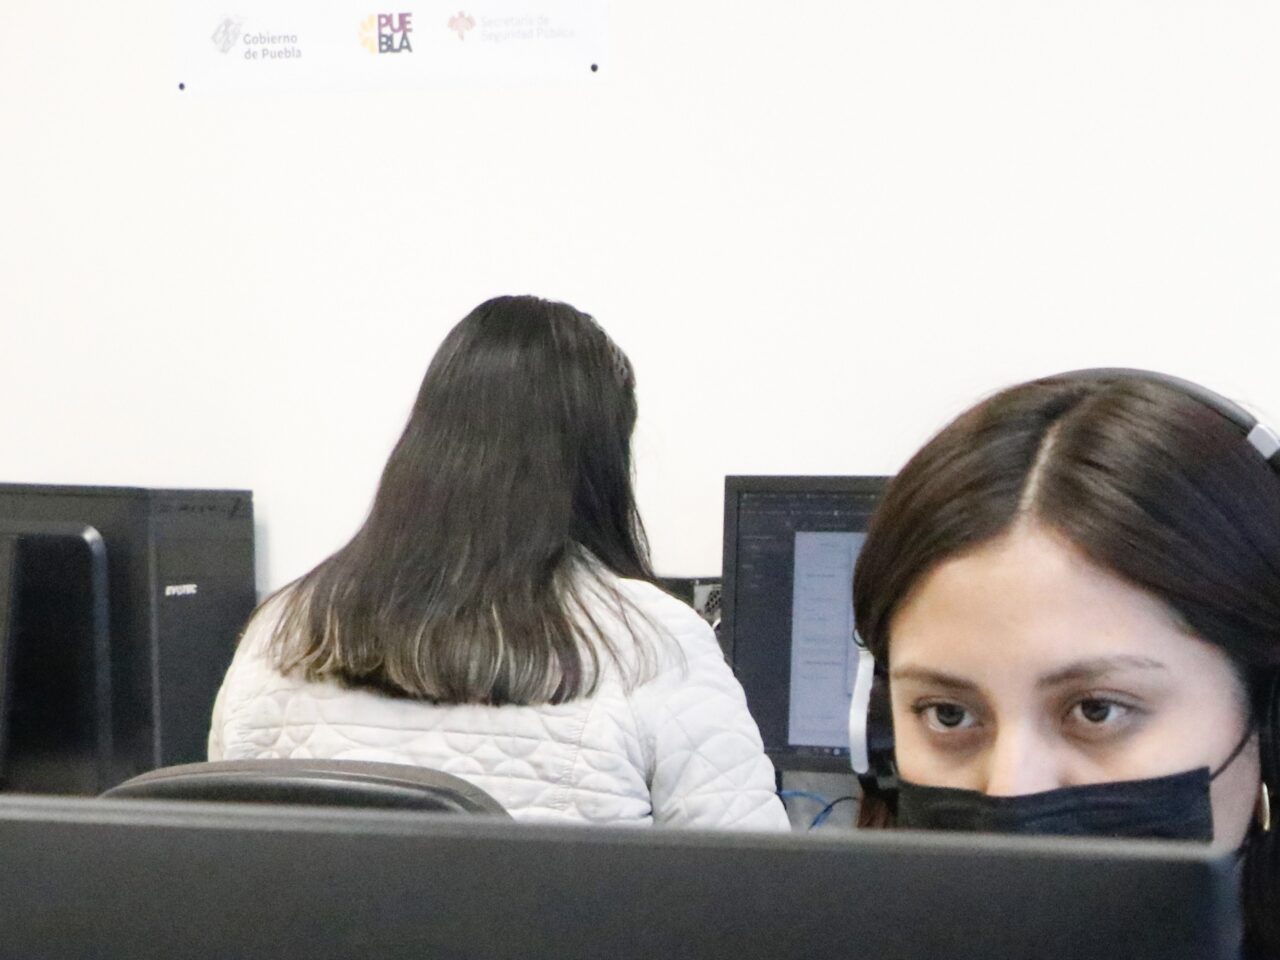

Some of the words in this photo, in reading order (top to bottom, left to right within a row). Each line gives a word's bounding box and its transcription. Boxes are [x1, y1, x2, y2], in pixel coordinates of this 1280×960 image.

[378, 12, 413, 33] PUE
[242, 32, 298, 45] Gobierno
[378, 31, 413, 53] BLA
[244, 48, 258, 60] de
[261, 47, 302, 59] Puebla
